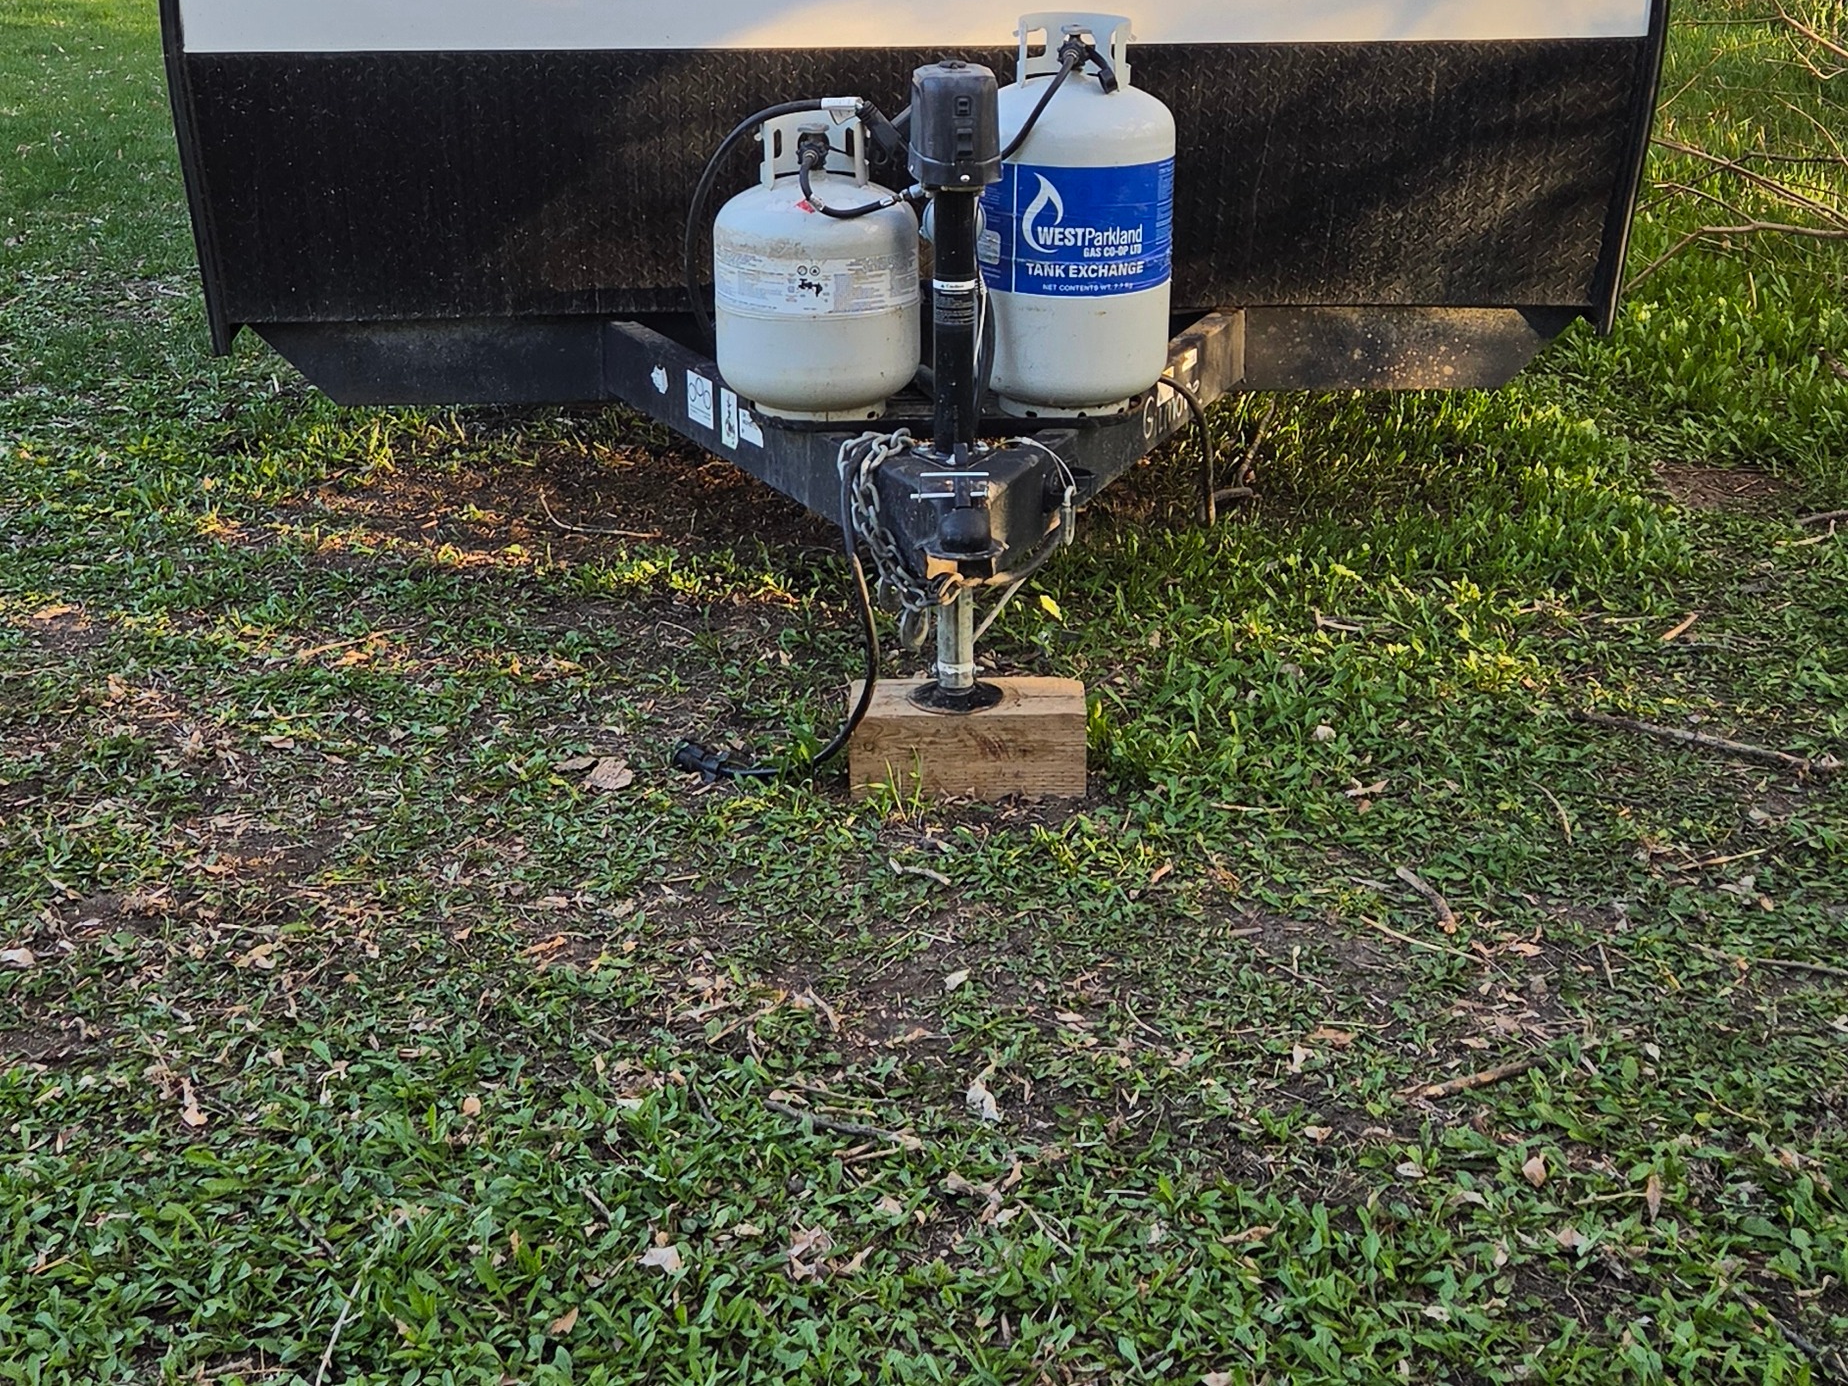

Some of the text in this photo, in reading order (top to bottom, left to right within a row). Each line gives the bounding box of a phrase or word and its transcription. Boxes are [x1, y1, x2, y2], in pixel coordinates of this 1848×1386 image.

[1083, 247, 1102, 258] GAS
[1103, 245, 1129, 257] CO-OP
[1026, 261, 1145, 278] TANK EXCHANGE
[1042, 283, 1058, 291] NET
[1058, 284, 1099, 292] CONTENTS
